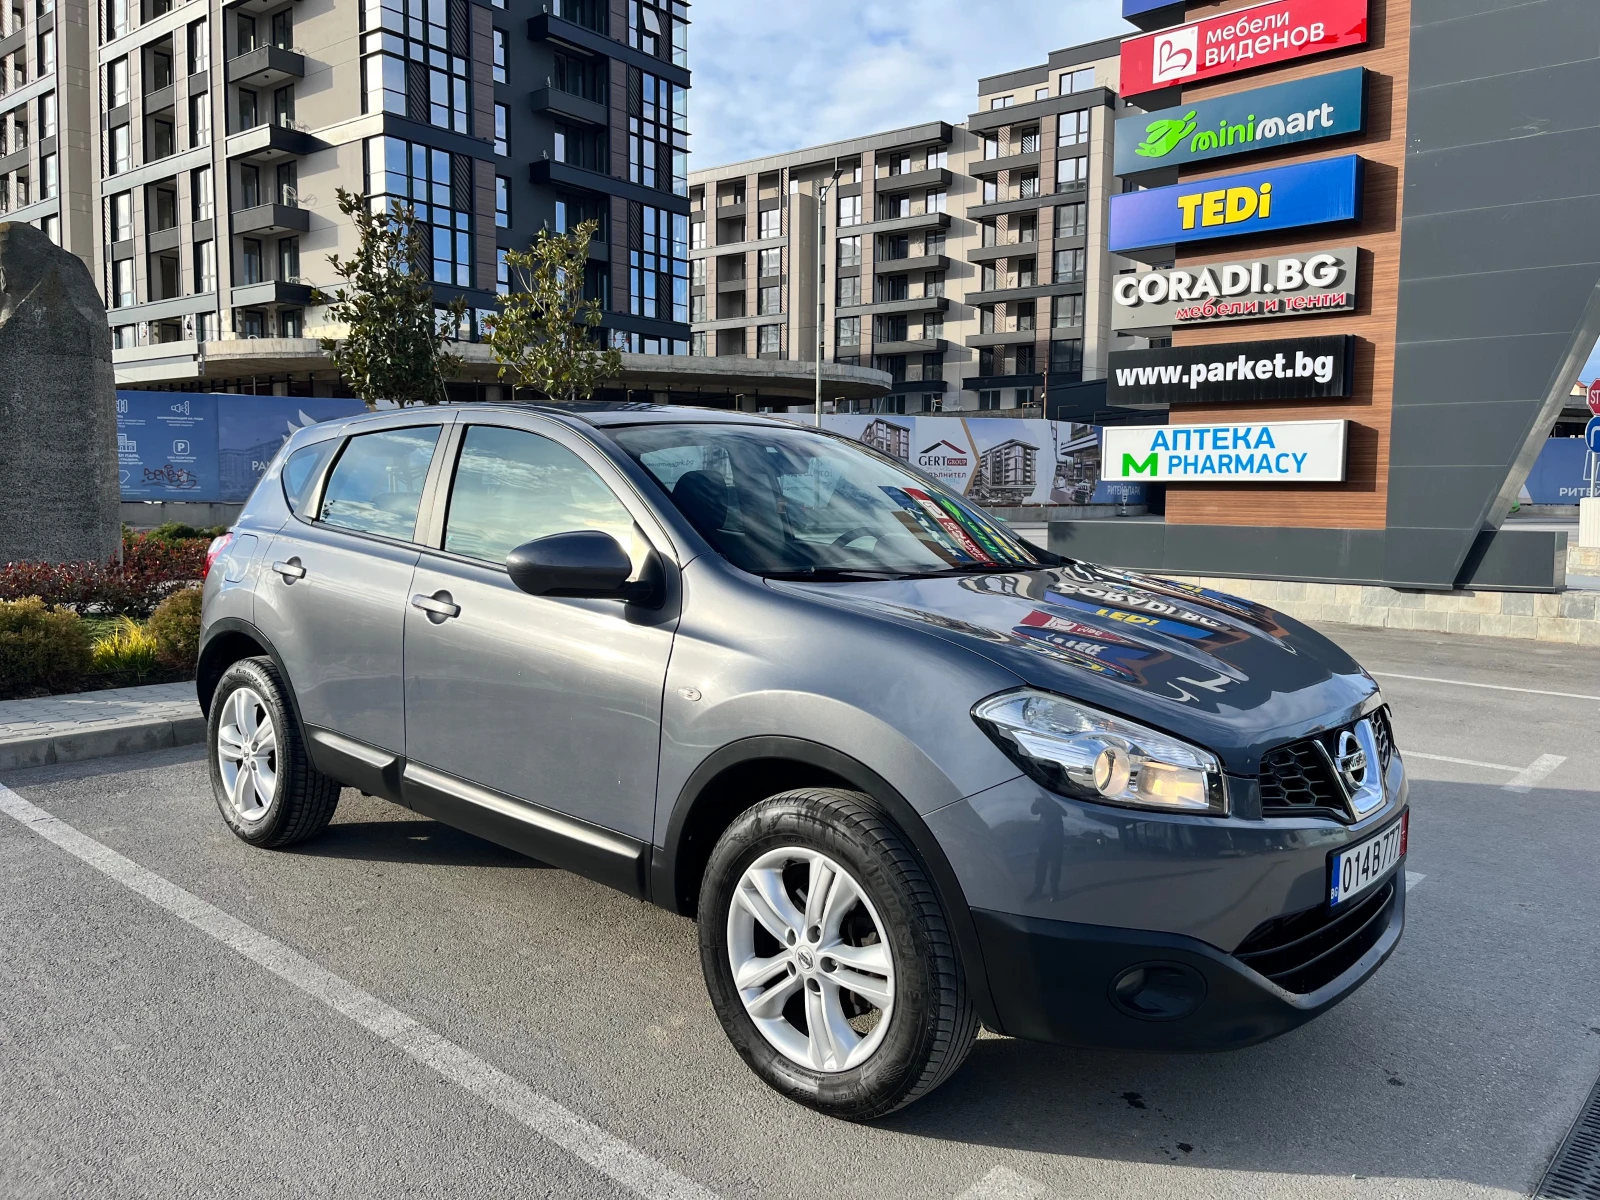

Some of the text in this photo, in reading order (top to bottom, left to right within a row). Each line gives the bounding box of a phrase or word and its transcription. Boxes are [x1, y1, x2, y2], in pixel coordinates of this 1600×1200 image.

[1205, 11, 1290, 44] мебели
[1191, 102, 1334, 153] minimart
[1177, 182, 1272, 230] TEDi
[1113, 254, 1339, 306] CORADI.BG
[1175, 292, 1346, 321] мебели и тенти
[1116, 350, 1334, 389] www.parket.bg
[1590, 389, 1600, 405] ST
[1150, 427, 1276, 452] АПТЕКА
[918, 455, 967, 466] GERT GROUP
[1167, 452, 1308, 475] PHARMACY
[1559, 484, 1600, 497] РИТЕЙ
[1331, 886, 1339, 900] BG
